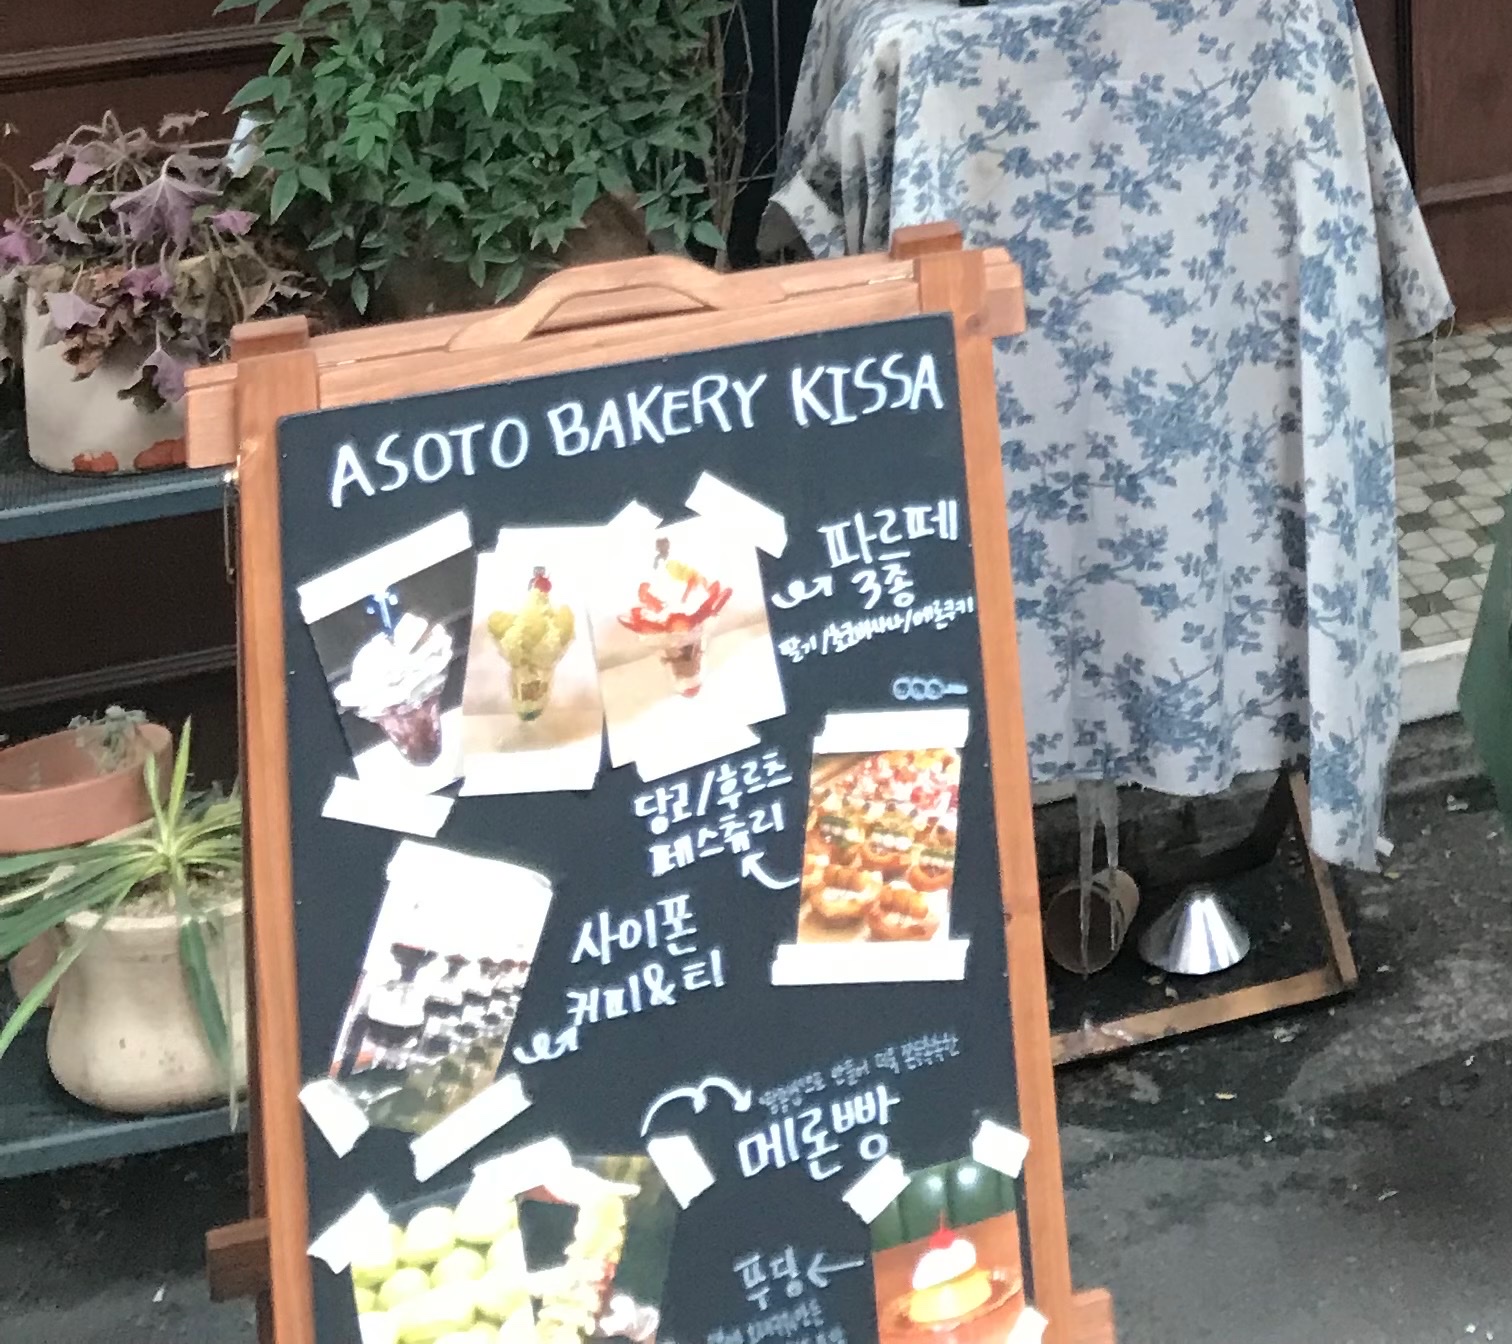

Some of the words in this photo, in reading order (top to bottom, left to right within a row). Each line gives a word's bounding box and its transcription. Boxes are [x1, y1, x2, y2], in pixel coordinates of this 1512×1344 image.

[328, 419, 529, 508] ASOTO
[549, 372, 769, 458] BAKERY
[791, 352, 945, 428] KISSA
[817, 499, 958, 569] 파르페
[649, 801, 785, 878] 페스츄리
[570, 893, 698, 966] 사이폰
[566, 948, 725, 1027] 커피&티
[737, 1084, 901, 1181] 메론빵
[733, 1244, 804, 1311] 푸딩
